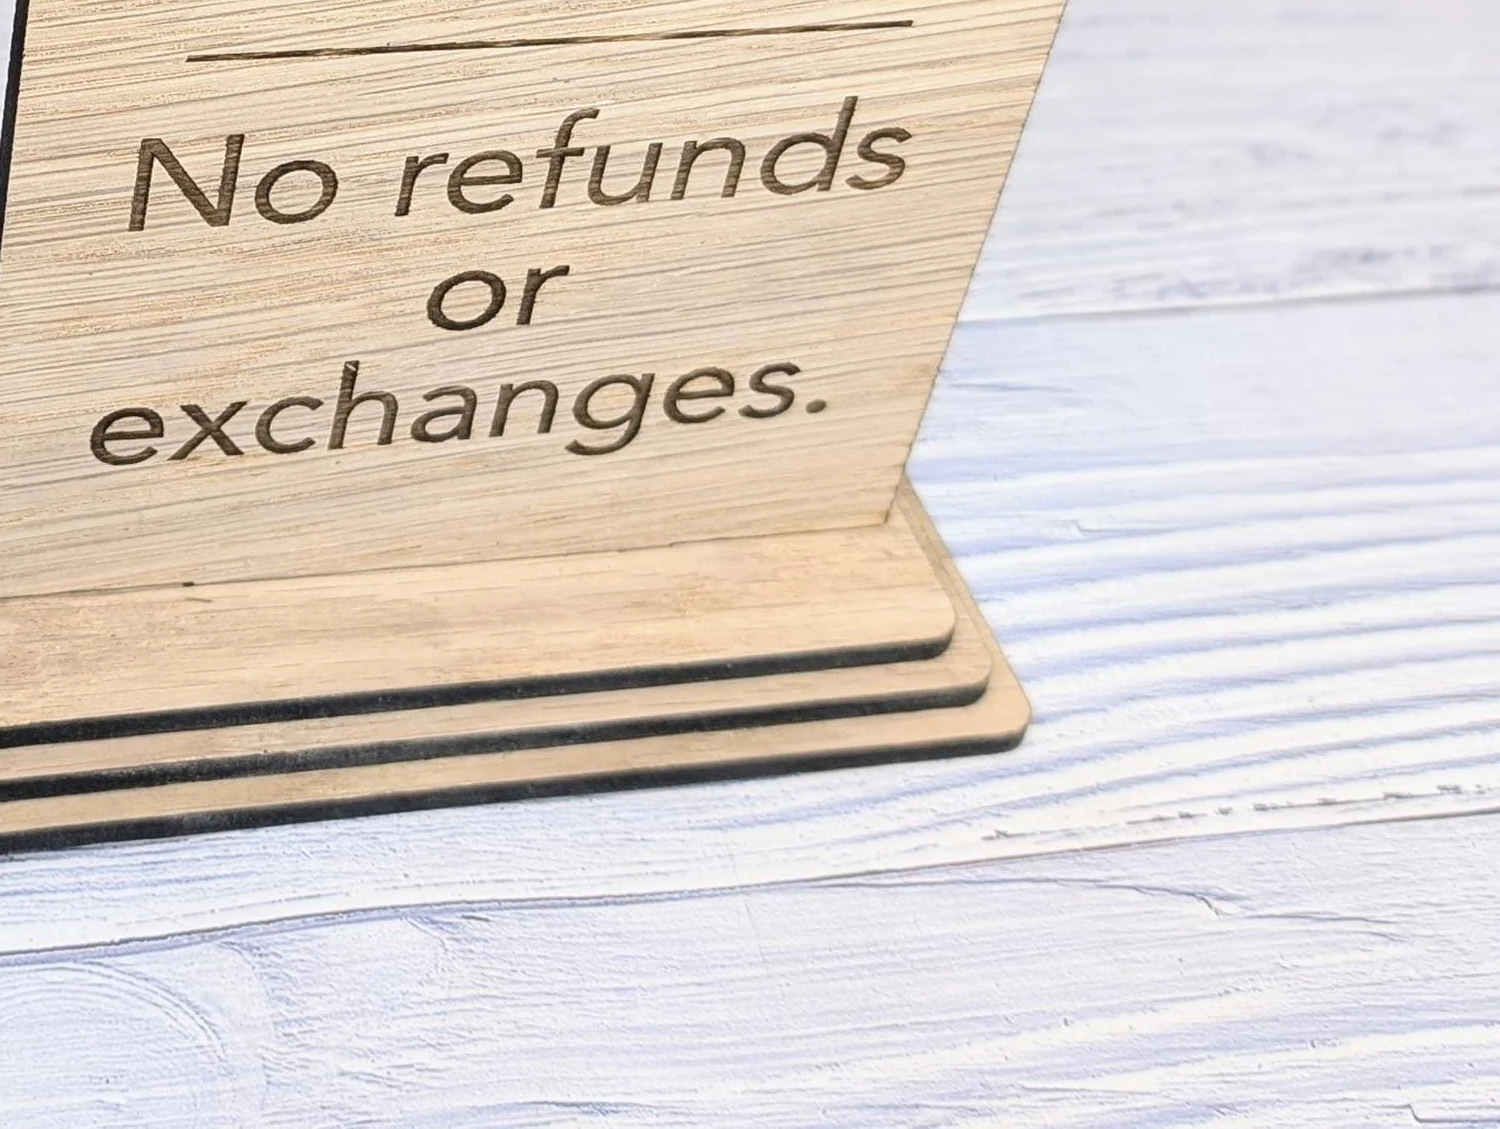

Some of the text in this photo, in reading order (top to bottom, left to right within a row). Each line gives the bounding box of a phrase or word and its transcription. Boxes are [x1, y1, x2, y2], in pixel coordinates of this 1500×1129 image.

[127, 96, 912, 231] No refunds
[427, 265, 570, 331] or
[90, 360, 826, 466] exchanges.
